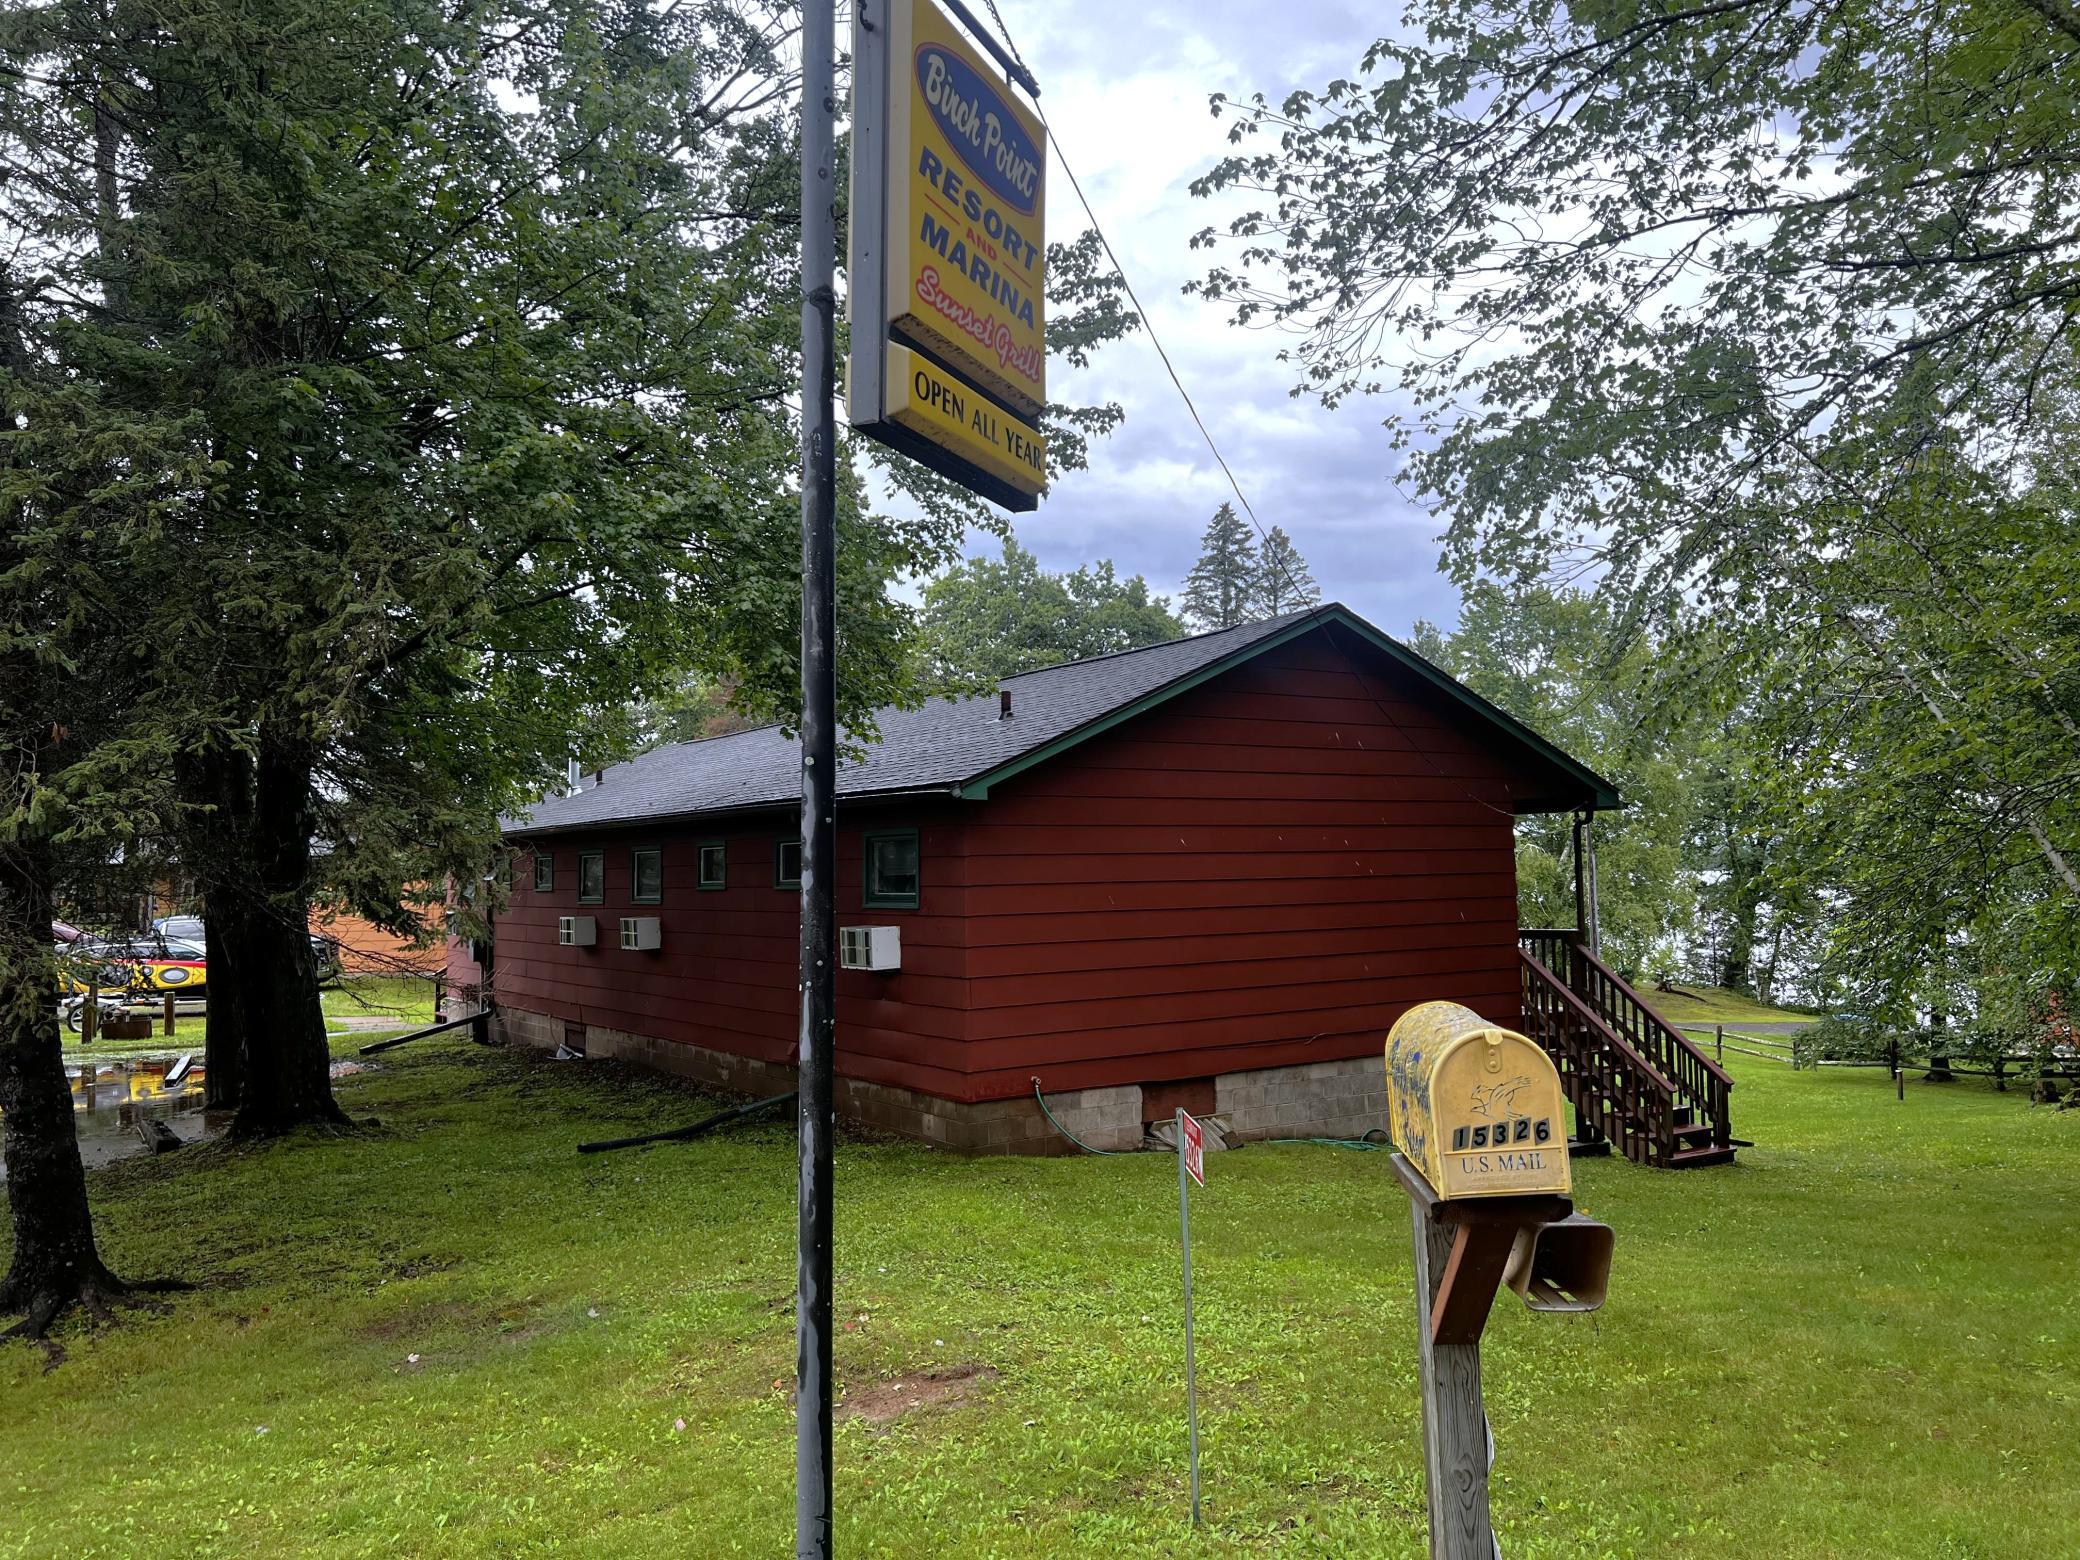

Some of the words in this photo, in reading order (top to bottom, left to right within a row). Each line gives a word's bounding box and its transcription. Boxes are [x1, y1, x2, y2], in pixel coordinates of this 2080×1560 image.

[925, 53, 981, 147] Birch
[984, 112, 1038, 198] Point
[919, 145, 1038, 271] RESORT
[966, 226, 997, 260] AND
[916, 265, 992, 349] Sunset
[994, 324, 1041, 383] Grill
[920, 212, 1034, 330] MARINA
[915, 371, 964, 424] OPEN
[971, 408, 999, 445] ALL
[1005, 427, 1042, 472] YEAR
[1458, 1119, 1550, 1148] 15326
[1462, 1155, 1494, 1174] U.S.
[1498, 1152, 1547, 1172] MAIL
